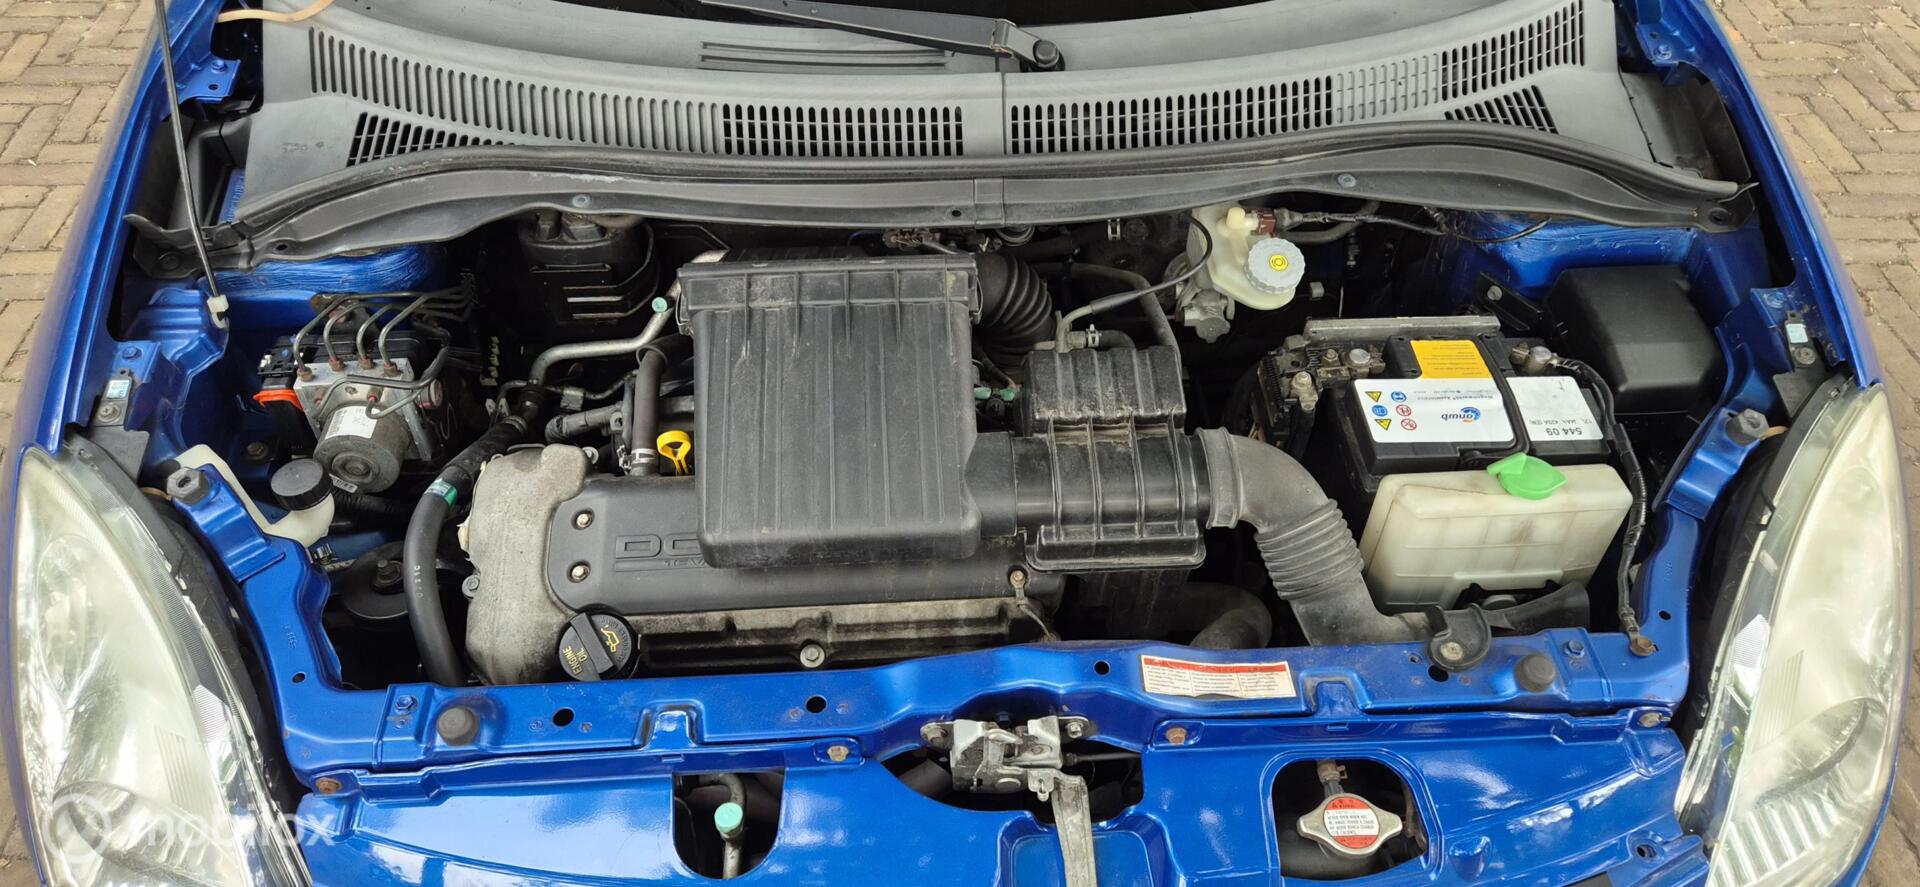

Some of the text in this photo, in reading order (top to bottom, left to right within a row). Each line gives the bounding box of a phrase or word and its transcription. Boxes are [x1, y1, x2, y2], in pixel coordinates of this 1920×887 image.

[1441, 413, 1474, 421] anwb
[1562, 427, 1583, 436] 544
[562, 645, 583, 675] ENGINE
[576, 647, 588, 662] OIL
